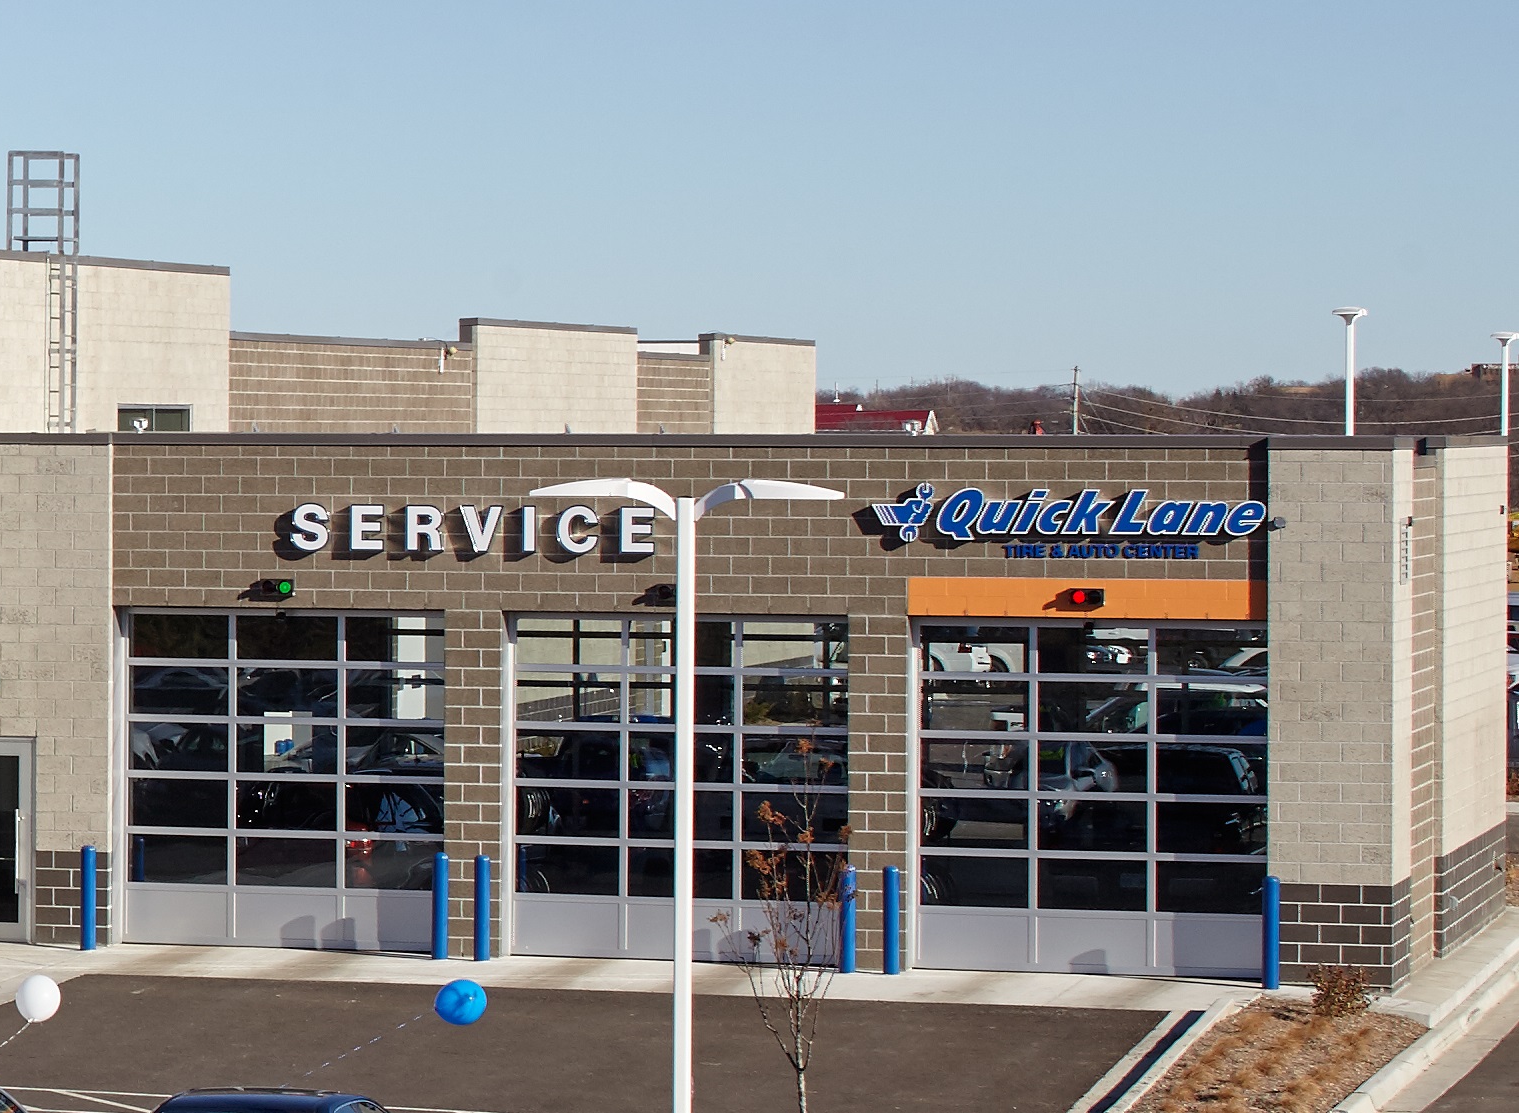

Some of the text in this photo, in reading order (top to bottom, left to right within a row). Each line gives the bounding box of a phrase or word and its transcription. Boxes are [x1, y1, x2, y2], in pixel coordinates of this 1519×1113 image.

[290, 503, 655, 554] SERVICE
[935, 487, 1266, 540] Quick Lane
[1004, 543, 1199, 559] TIRE & AUTO CENTER
